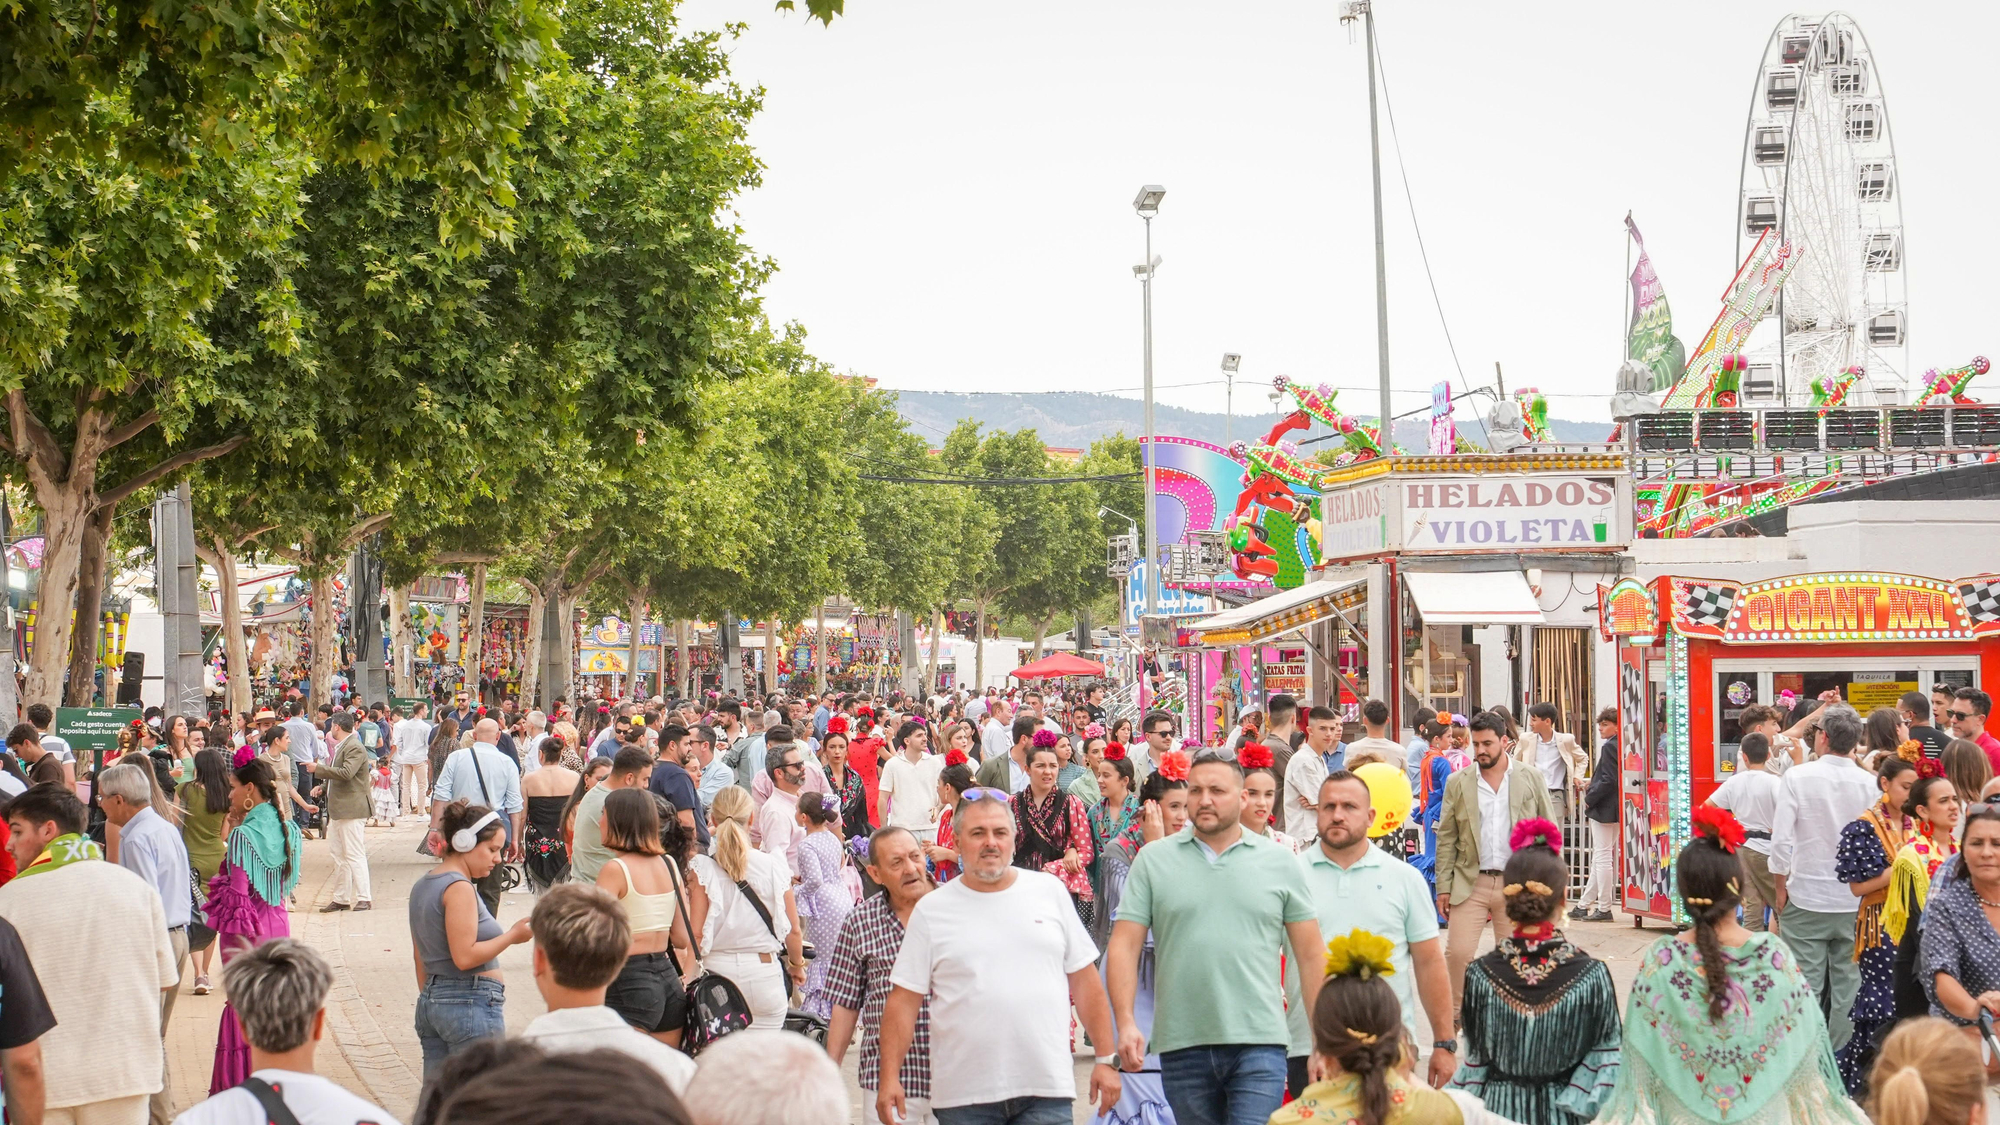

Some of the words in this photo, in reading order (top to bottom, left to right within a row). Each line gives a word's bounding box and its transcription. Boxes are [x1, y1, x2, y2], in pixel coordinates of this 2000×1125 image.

[1327, 487, 1381, 525] HELADOS
[1407, 482, 1613, 508] HELADOS
[1429, 518, 1591, 544] VIOLETA
[1748, 587, 1880, 631] GIGANT
[1887, 588, 1950, 629] XXL
